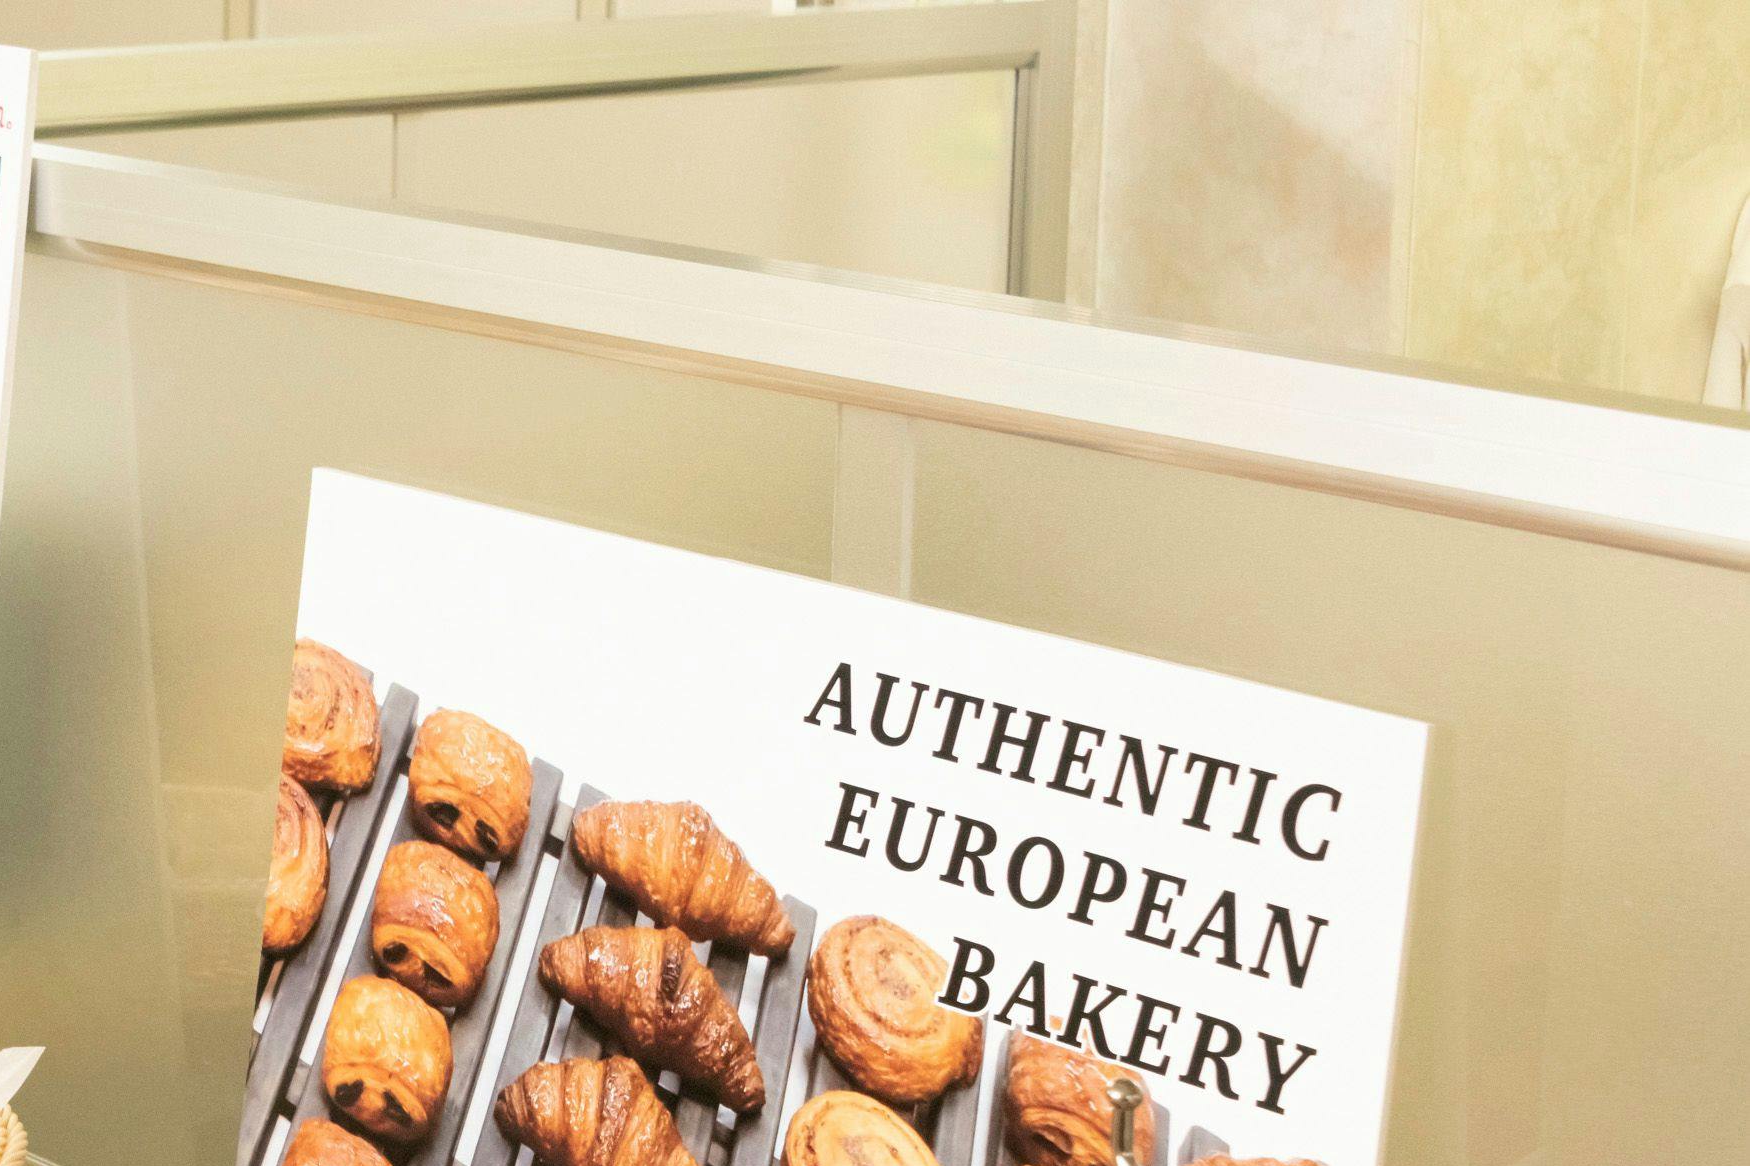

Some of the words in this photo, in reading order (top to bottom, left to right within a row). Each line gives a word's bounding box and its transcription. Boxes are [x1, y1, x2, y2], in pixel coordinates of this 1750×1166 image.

[803, 661, 1343, 863] AUTHENTIC
[824, 781, 1329, 989] EUROPEAN
[936, 936, 1318, 1116] BAKERY
